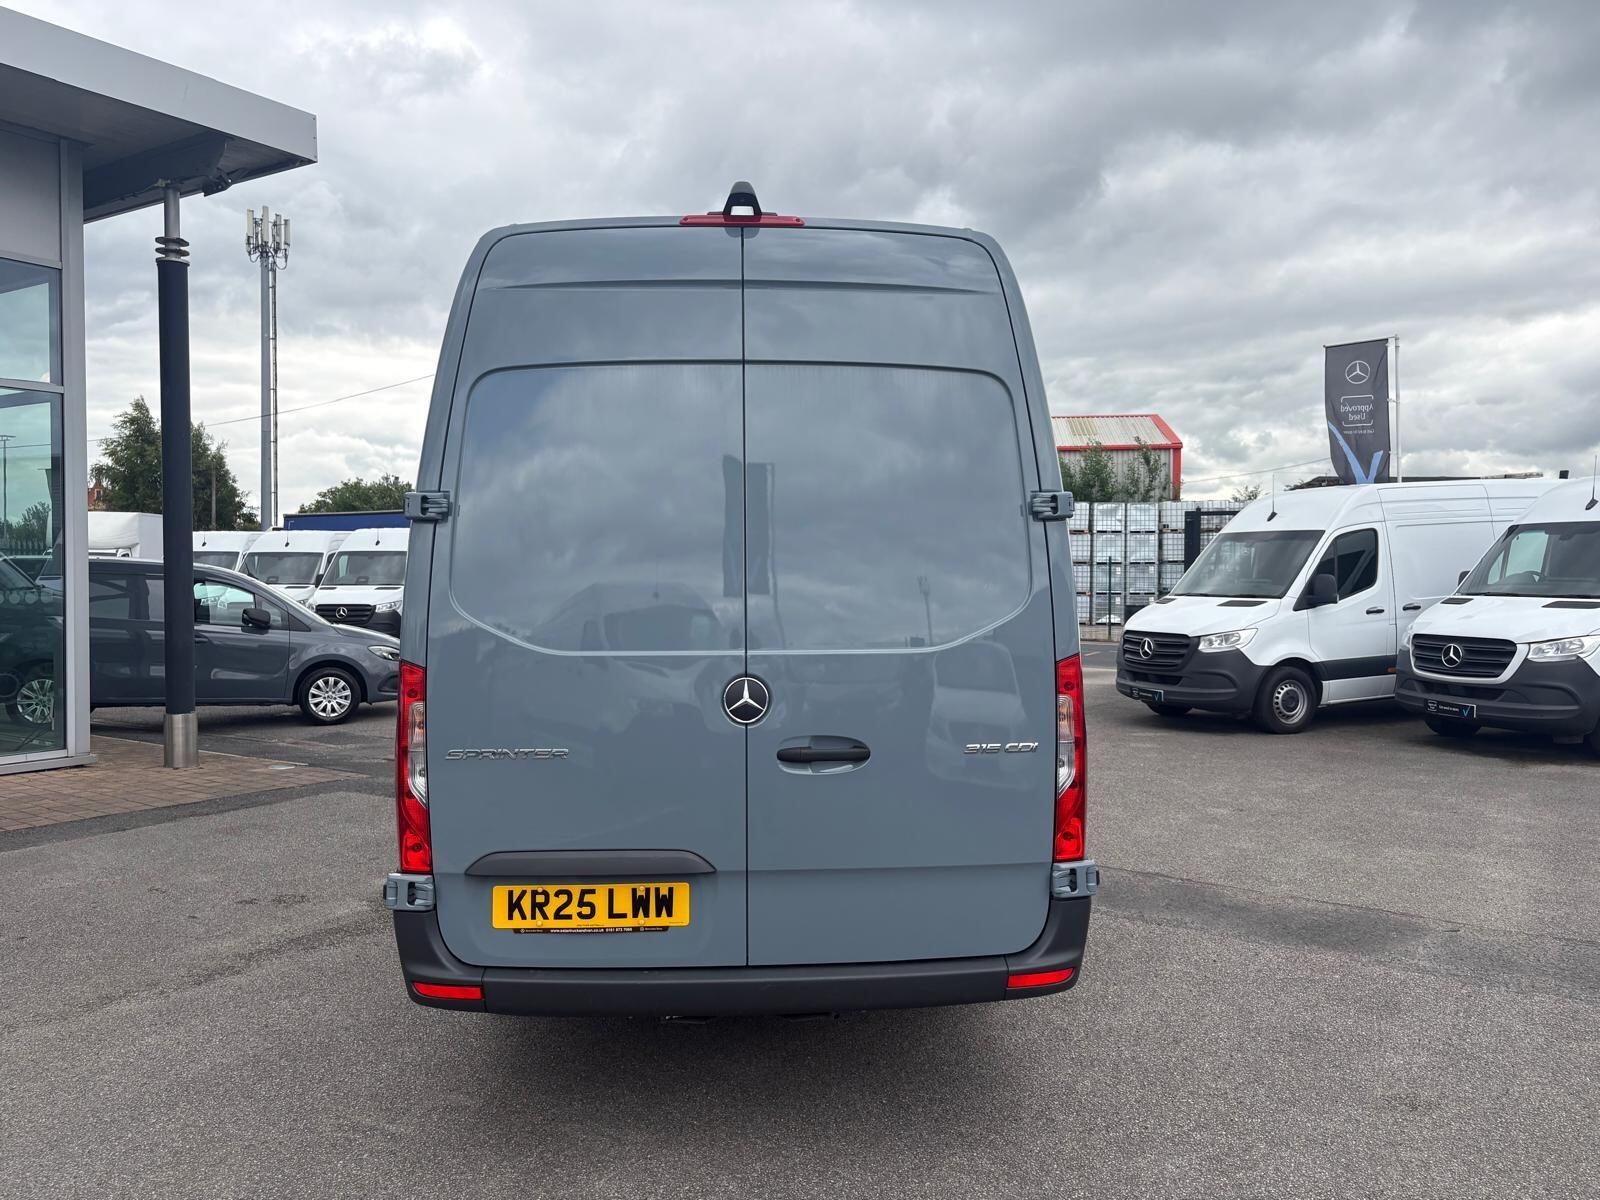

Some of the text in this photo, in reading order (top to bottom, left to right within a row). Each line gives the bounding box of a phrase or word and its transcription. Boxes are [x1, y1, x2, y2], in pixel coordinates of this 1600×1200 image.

[445, 747, 569, 760] SPRINTER
[964, 743, 1001, 754] 315
[507, 887, 674, 920] KR25 LWW
